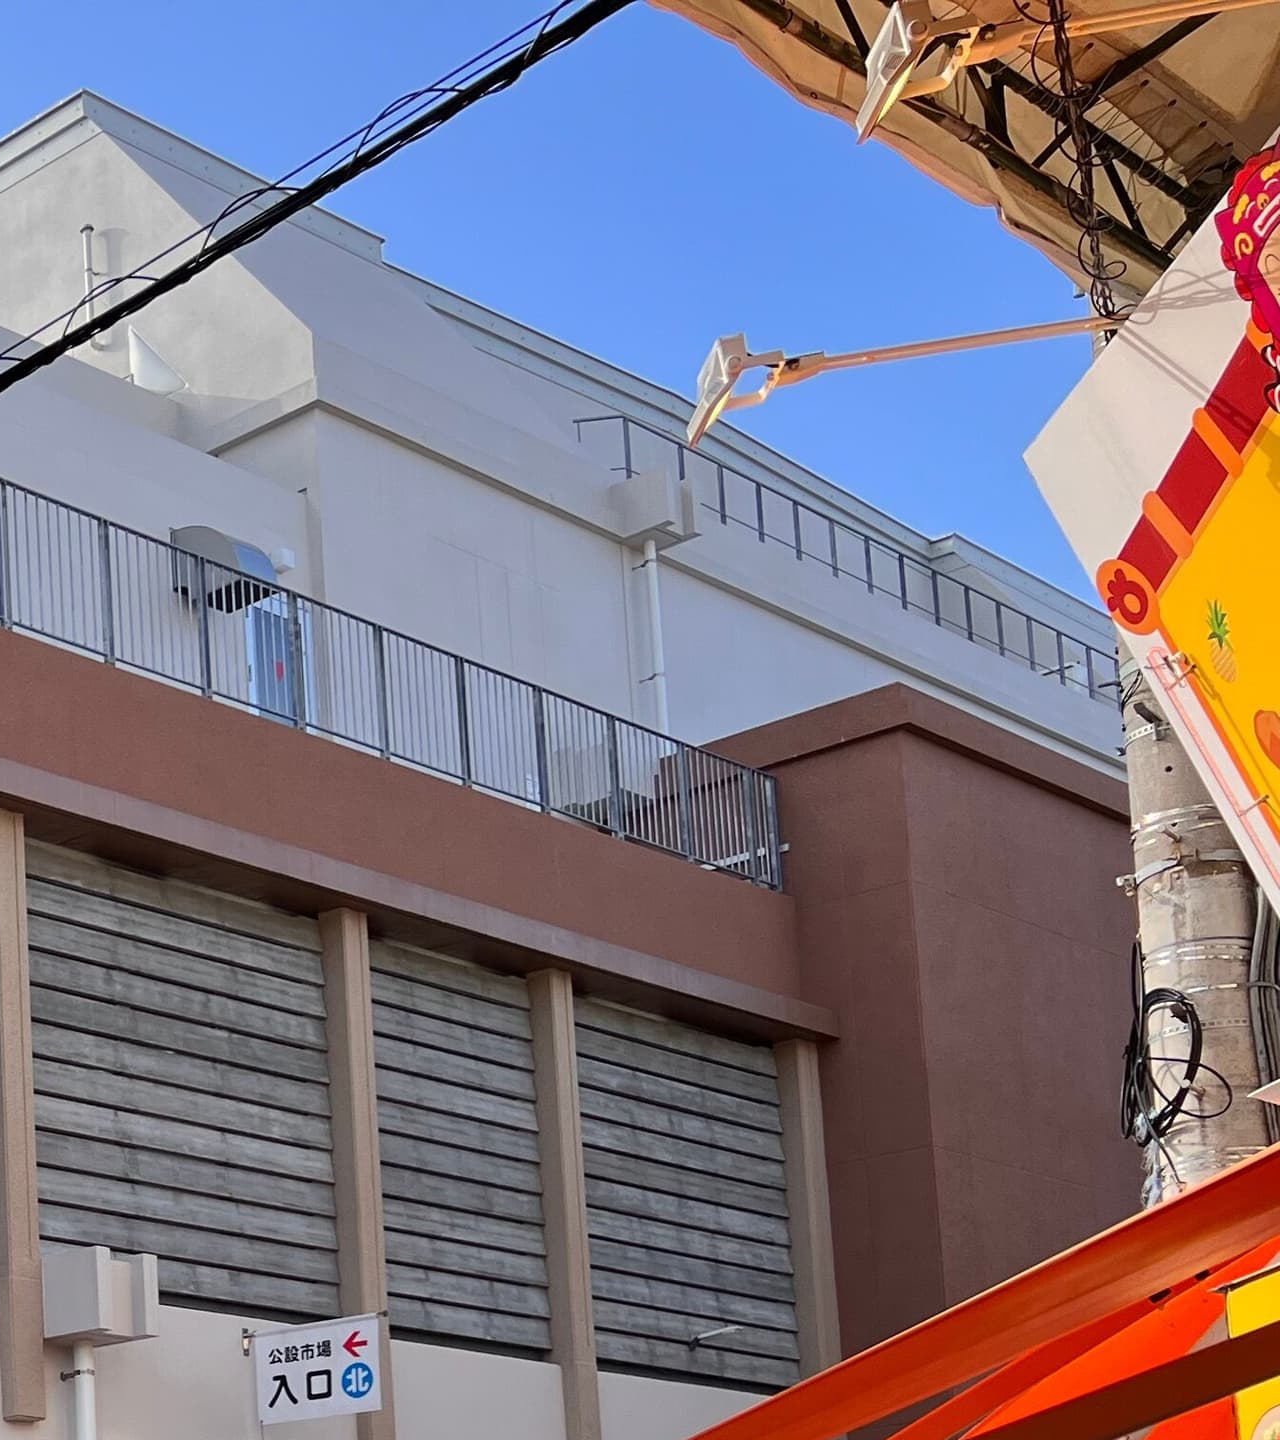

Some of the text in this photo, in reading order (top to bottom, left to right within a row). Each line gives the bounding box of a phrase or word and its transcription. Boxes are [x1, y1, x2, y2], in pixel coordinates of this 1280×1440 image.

[268, 1340, 332, 1365] 公設市場
[268, 1367, 370, 1408] 入口 北
